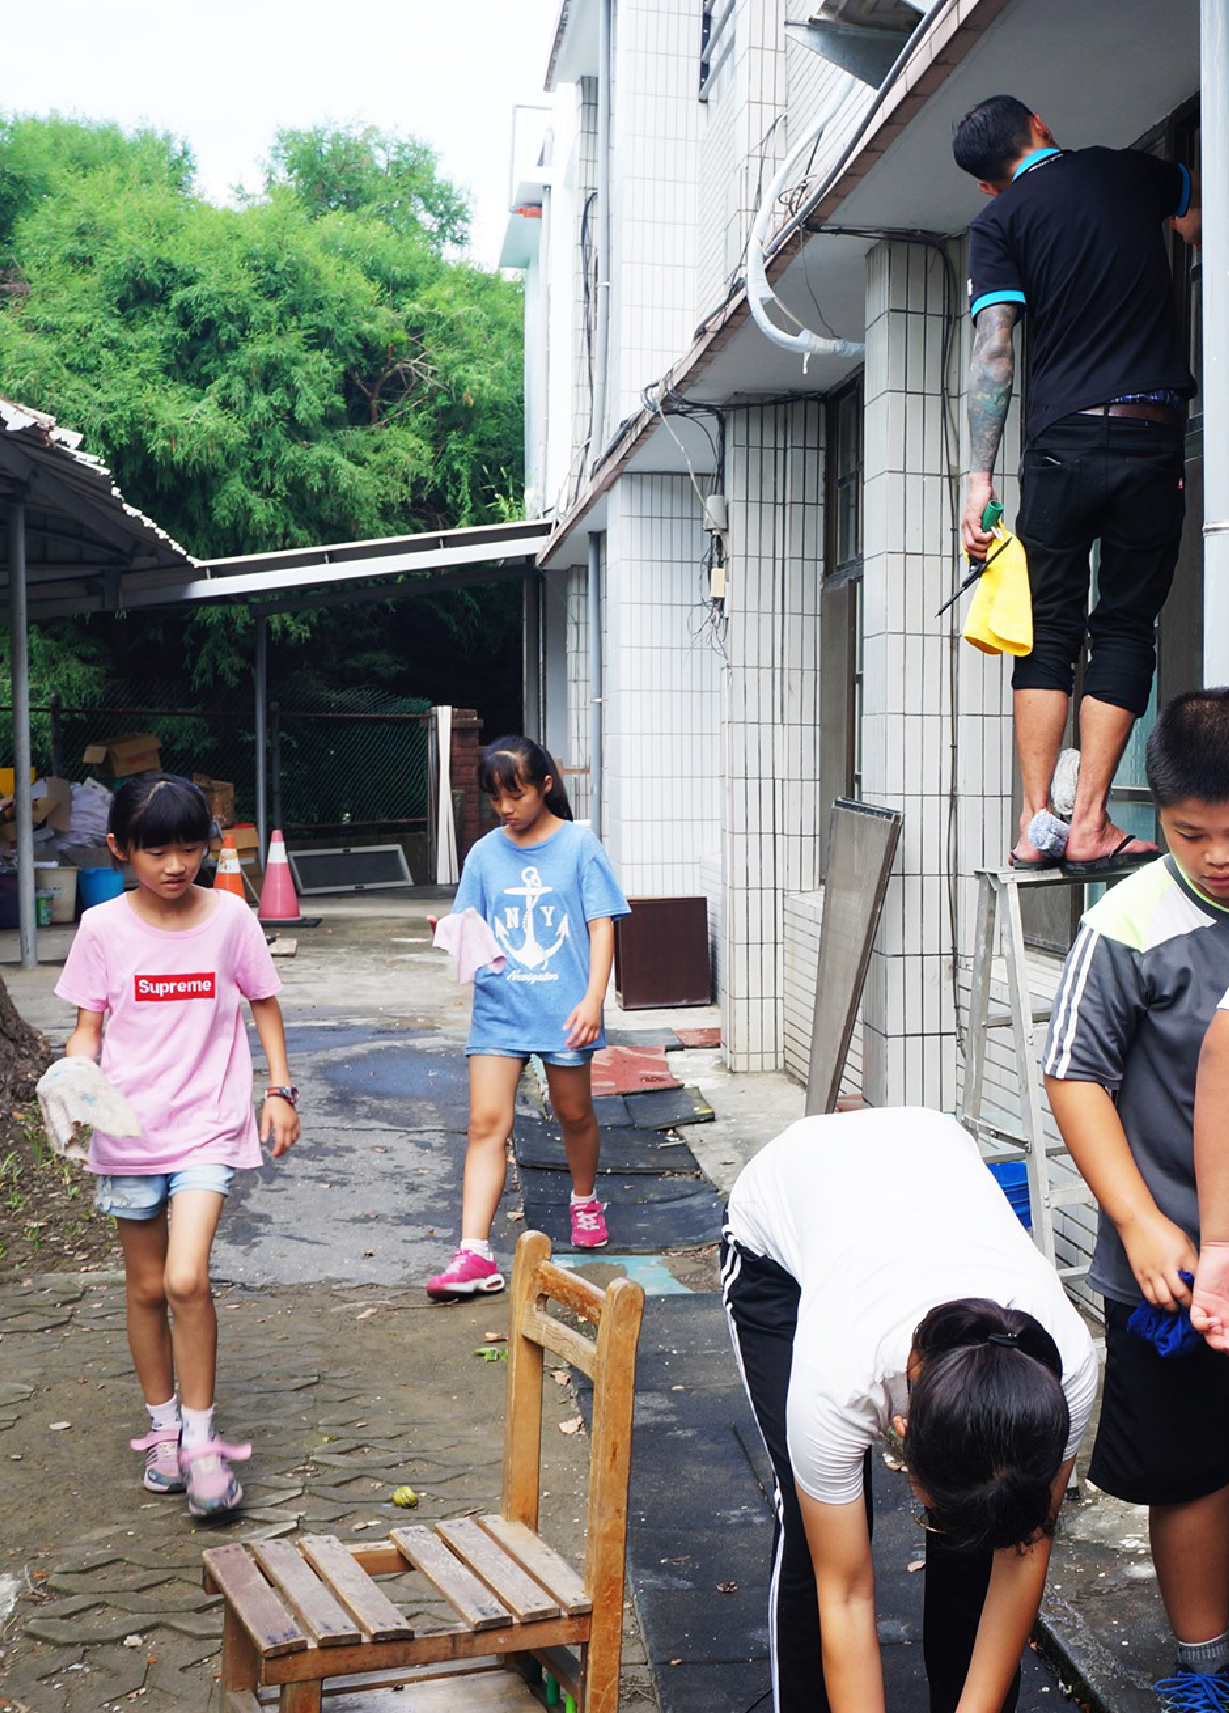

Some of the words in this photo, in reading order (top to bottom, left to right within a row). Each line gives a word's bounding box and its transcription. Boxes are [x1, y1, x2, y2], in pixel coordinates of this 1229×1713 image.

[504, 907, 519, 928] N
[540, 906, 555, 926] Y
[138, 980, 212, 997] Supreme
